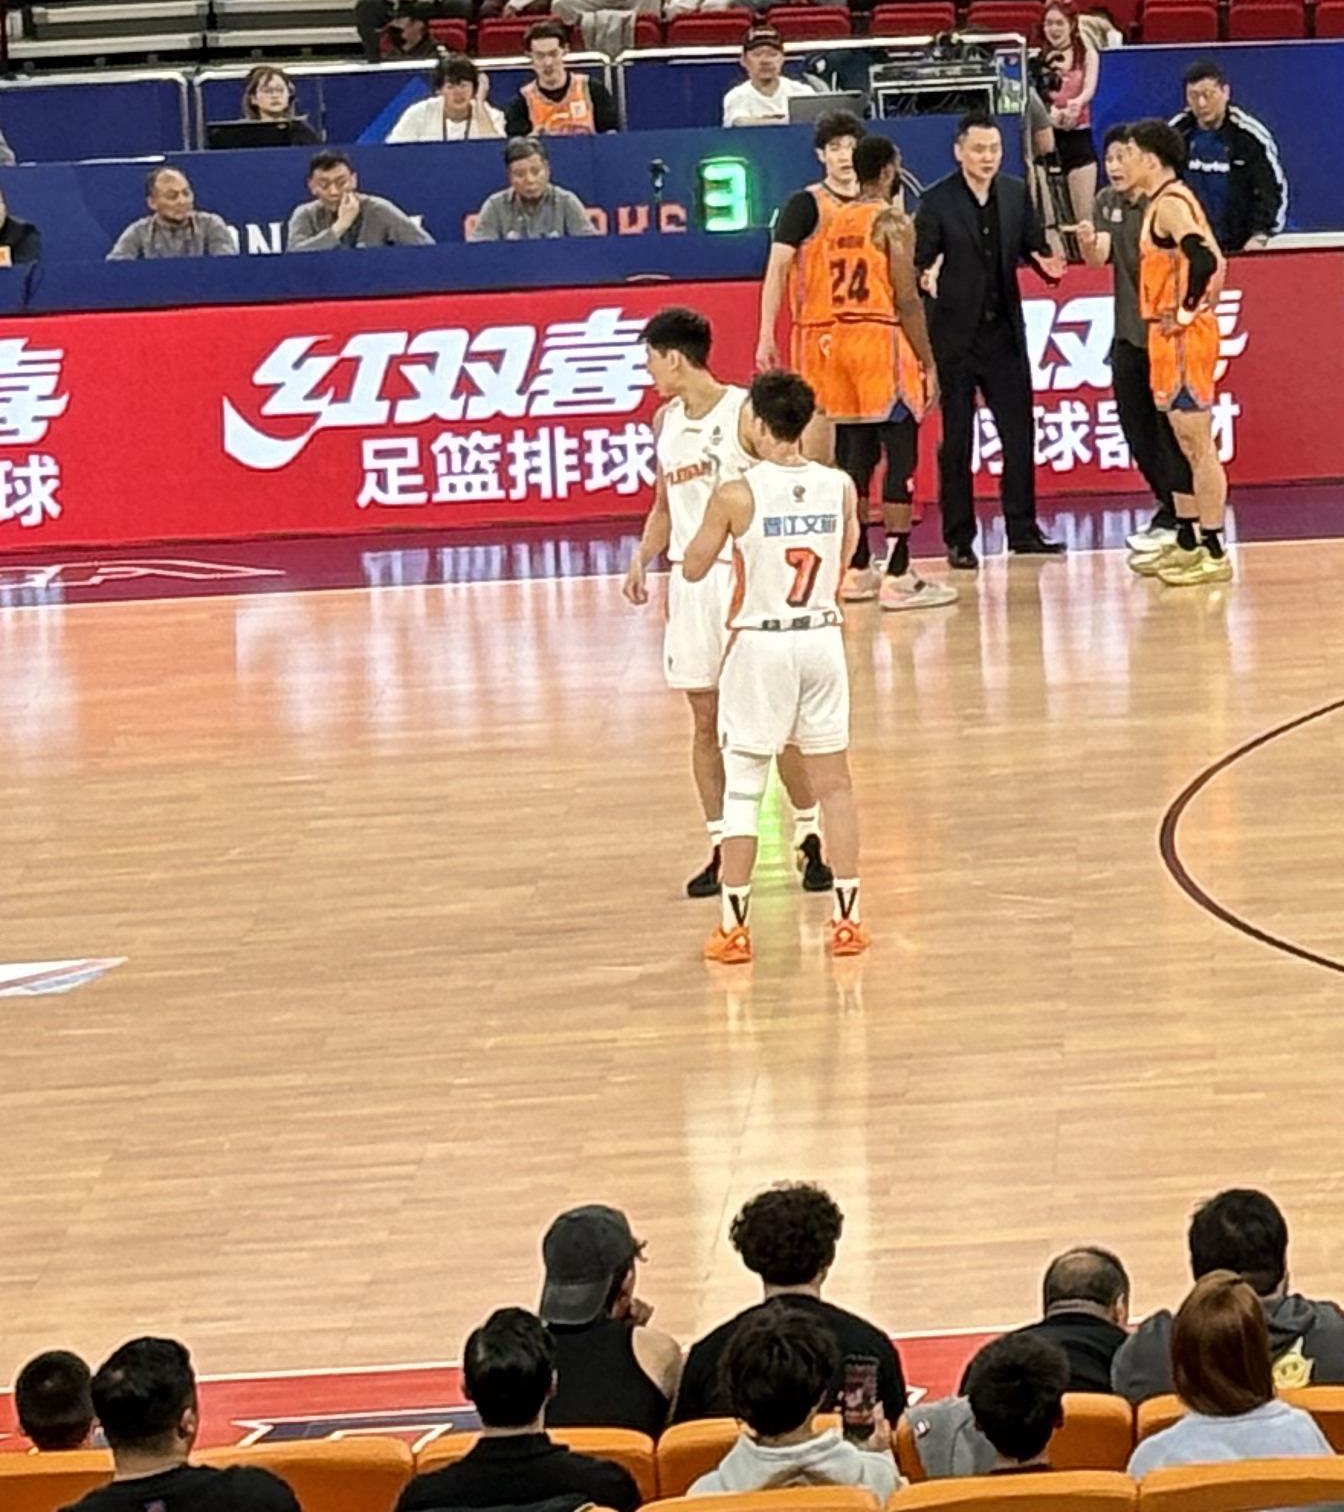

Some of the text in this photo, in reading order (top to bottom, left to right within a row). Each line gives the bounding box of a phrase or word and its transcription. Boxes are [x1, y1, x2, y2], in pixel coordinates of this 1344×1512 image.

[702, 159, 749, 233] 3
[223, 308, 656, 469] 红双喜
[356, 424, 656, 509] 足篮排球
[785, 546, 823, 608] 7
